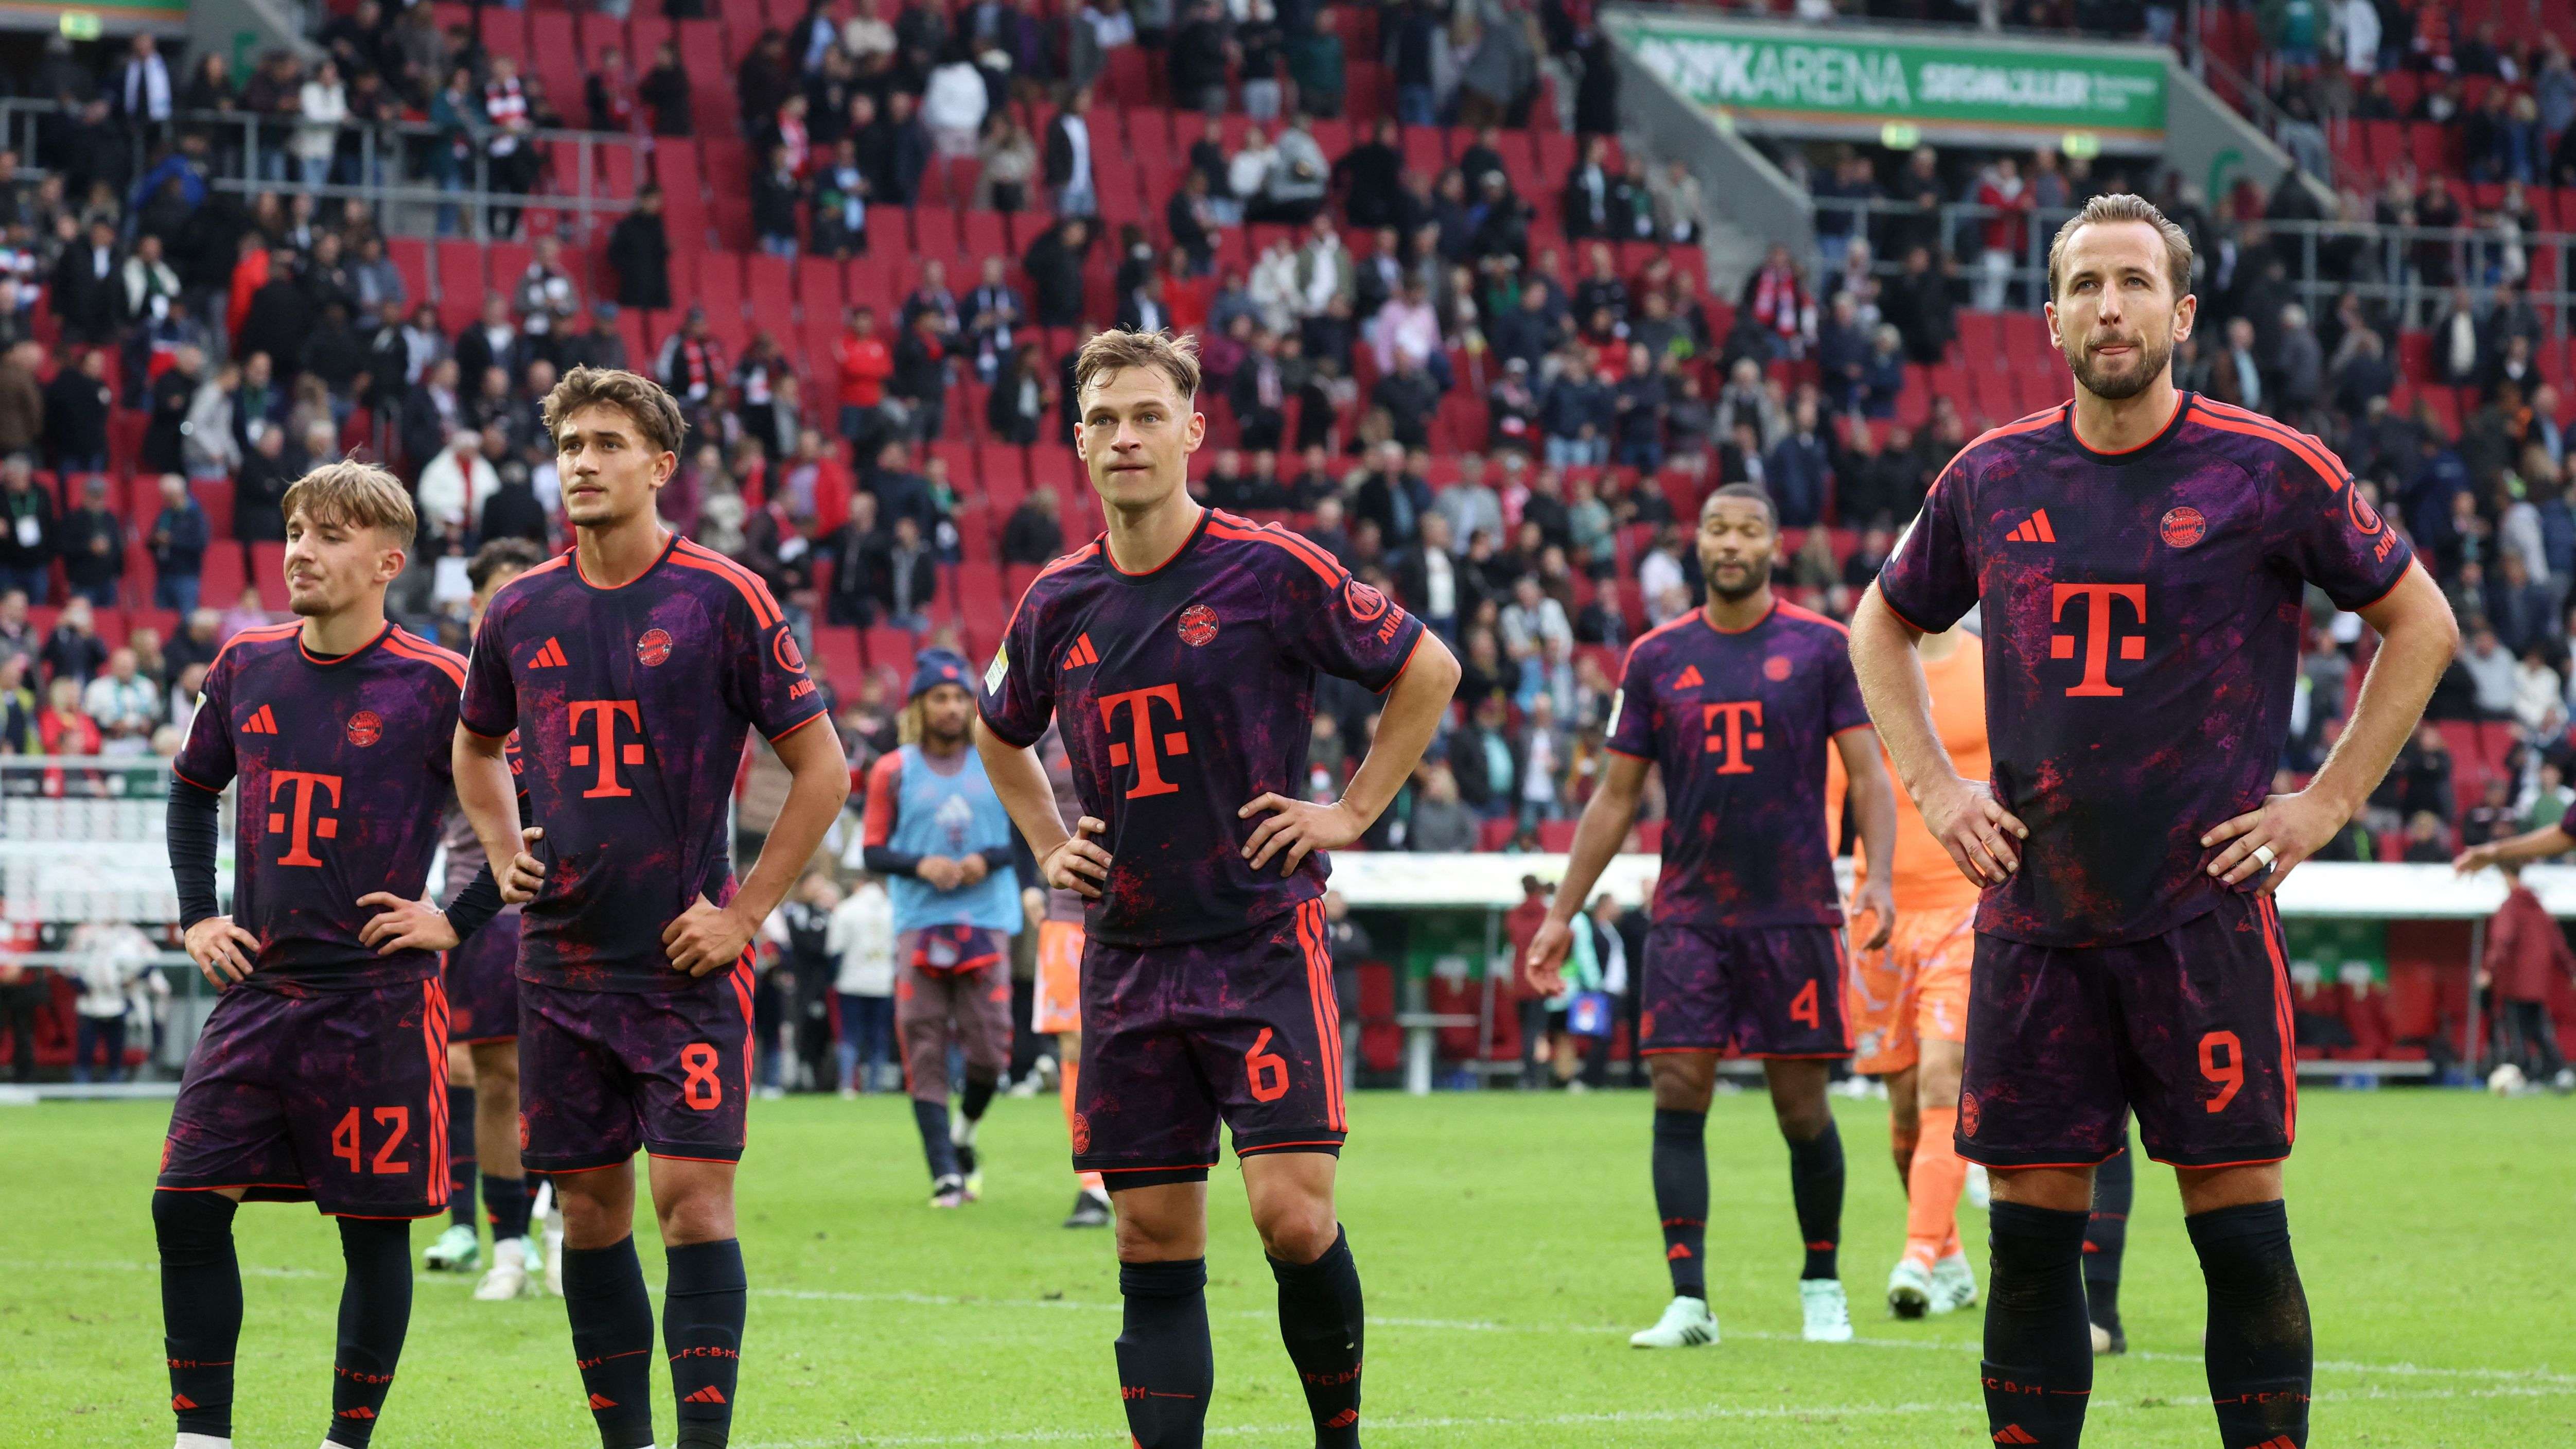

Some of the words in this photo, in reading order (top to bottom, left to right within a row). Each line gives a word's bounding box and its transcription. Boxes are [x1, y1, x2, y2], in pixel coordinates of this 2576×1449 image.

[2051, 583, 2146, 696] T
[569, 700, 644, 798] T
[1099, 683, 1188, 799] T
[1704, 701, 1764, 775] T
[269, 770, 342, 867] T
[1790, 979, 1818, 1029] 4
[680, 1043, 722, 1111] 8
[1245, 1026, 1289, 1103] 6
[2198, 1030, 2244, 1113] 9
[332, 1106, 409, 1174] 42
